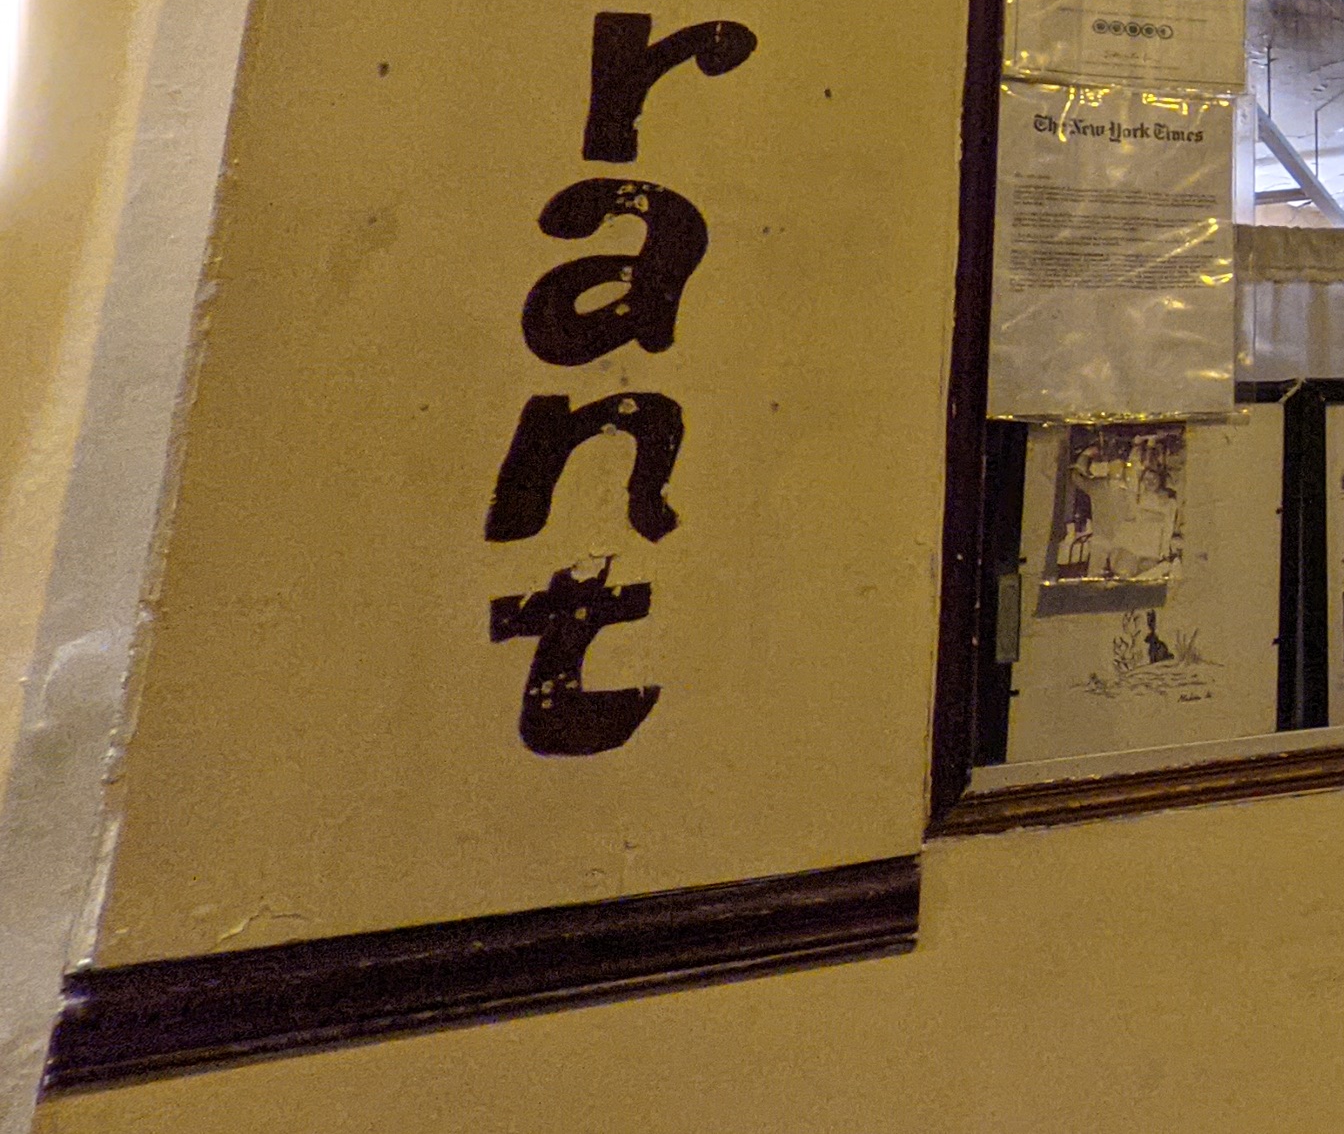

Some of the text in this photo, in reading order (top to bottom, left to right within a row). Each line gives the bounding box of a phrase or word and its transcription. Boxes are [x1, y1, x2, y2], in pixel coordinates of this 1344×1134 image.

[1068, 118, 1106, 139] New
[1109, 120, 1152, 144] York
[1152, 123, 1205, 144] Times
